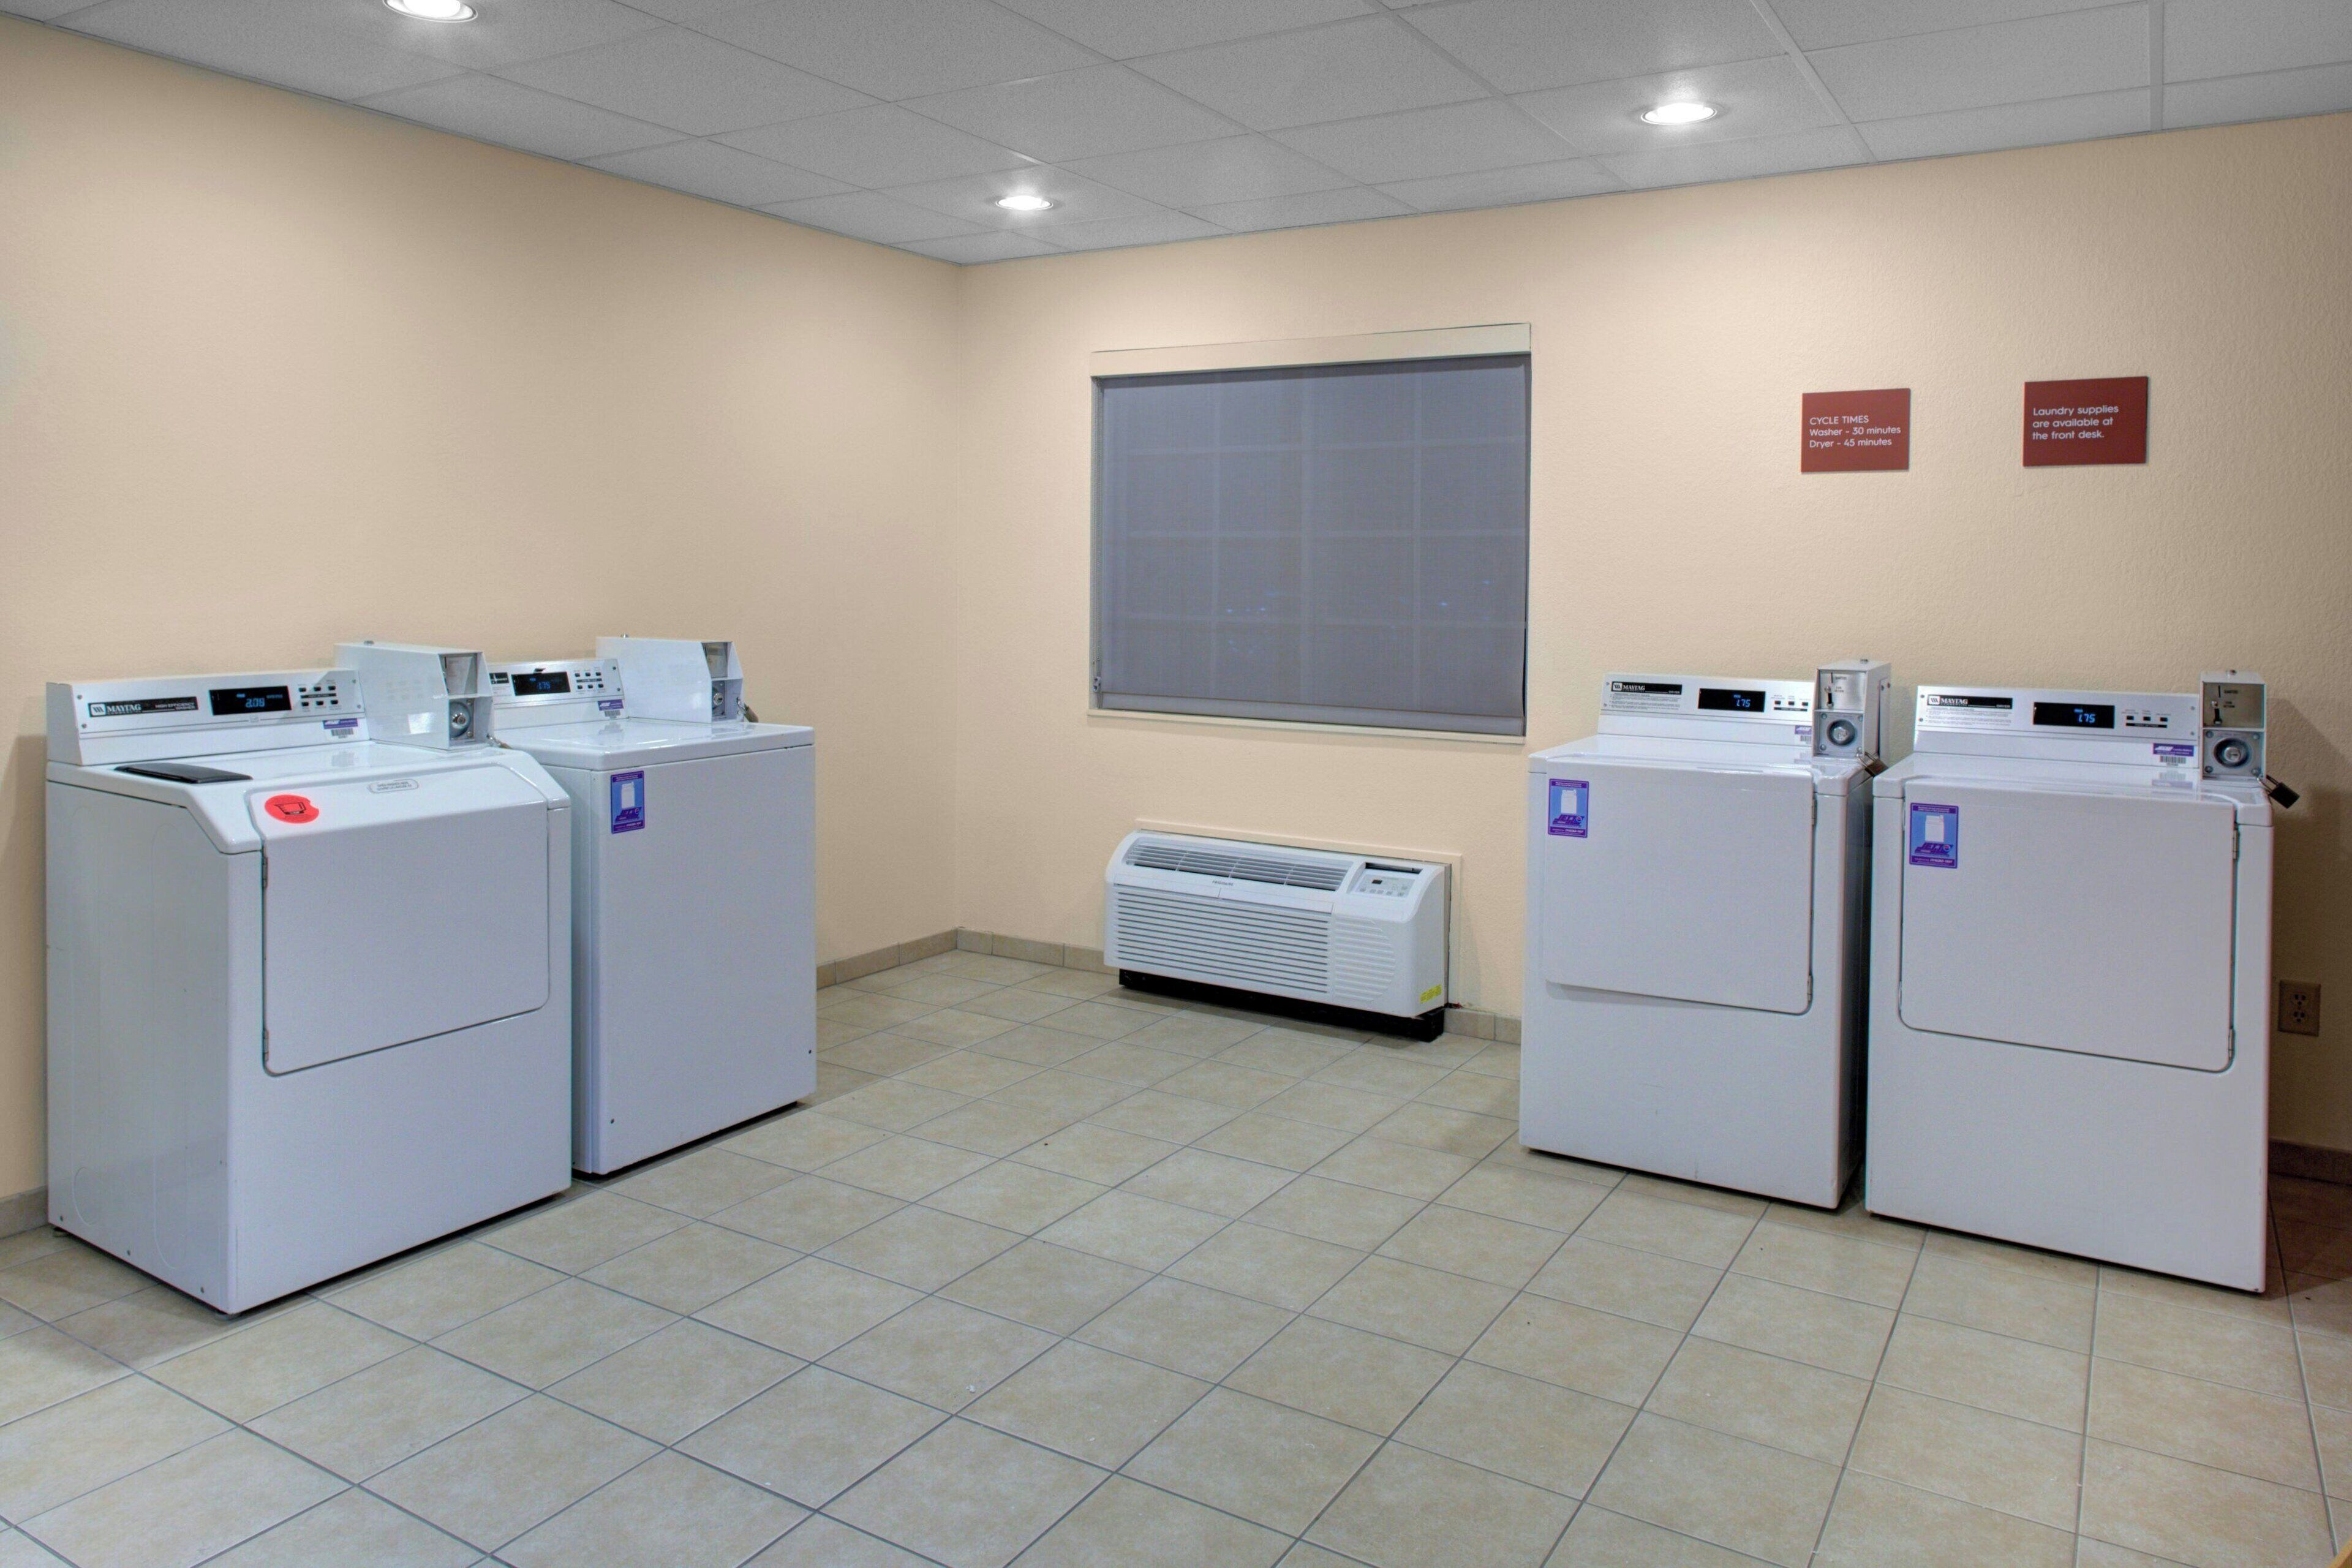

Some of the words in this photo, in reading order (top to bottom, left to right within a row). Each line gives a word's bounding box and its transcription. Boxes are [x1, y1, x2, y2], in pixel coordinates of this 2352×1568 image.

[2033, 407, 2075, 417] Laundry
[2077, 405, 2119, 415] supplies
[1809, 417, 1839, 425] CYCLE
[1842, 415, 1869, 424] TIMES
[2052, 418, 2099, 428] available
[2103, 417, 2113, 426] at
[1866, 426, 1901, 434] minutes
[2051, 431, 2075, 439] front
[2078, 430, 2105, 439] desk.
[1809, 440, 1834, 449] Dryer
[1858, 438, 1892, 447] minutes
[107, 704, 141, 712] MAYTAG
